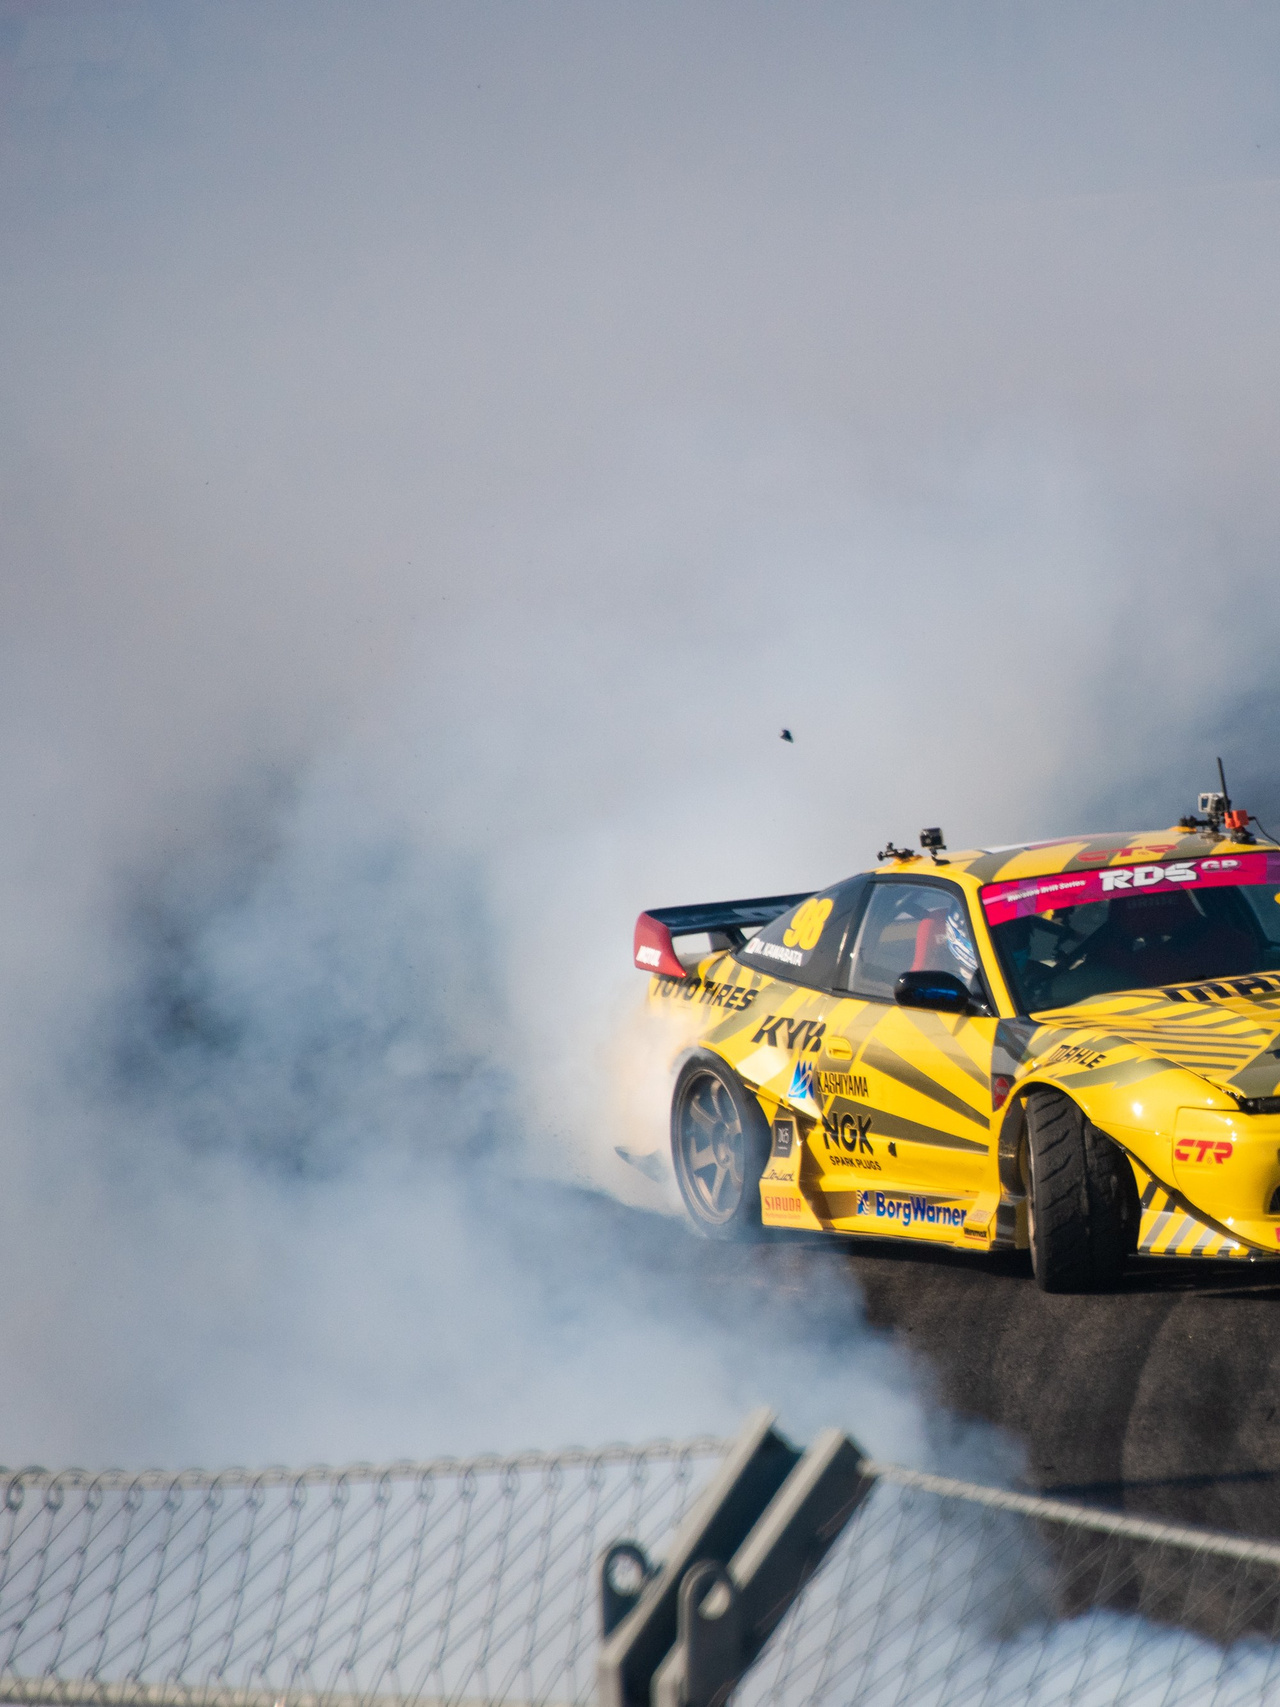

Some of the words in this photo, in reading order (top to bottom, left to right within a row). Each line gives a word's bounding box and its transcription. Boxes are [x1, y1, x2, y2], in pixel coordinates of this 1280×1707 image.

[1059, 880, 1086, 890] Series
[1099, 862, 1198, 892] RDS
[1201, 859, 1240, 873] GP
[783, 898, 833, 951] 98
[700, 981, 760, 1012] TIRES
[751, 1015, 826, 1053] KYB
[1048, 1044, 1107, 1070] MAHLE
[816, 1071, 869, 1098] KASHIYAMA
[821, 1112, 875, 1156] NGK
[829, 1155, 855, 1168] SPARK
[856, 1158, 882, 1172] PLUGS
[1174, 1138, 1234, 1165] CTR
[874, 1190, 968, 1227] BorgWarner
